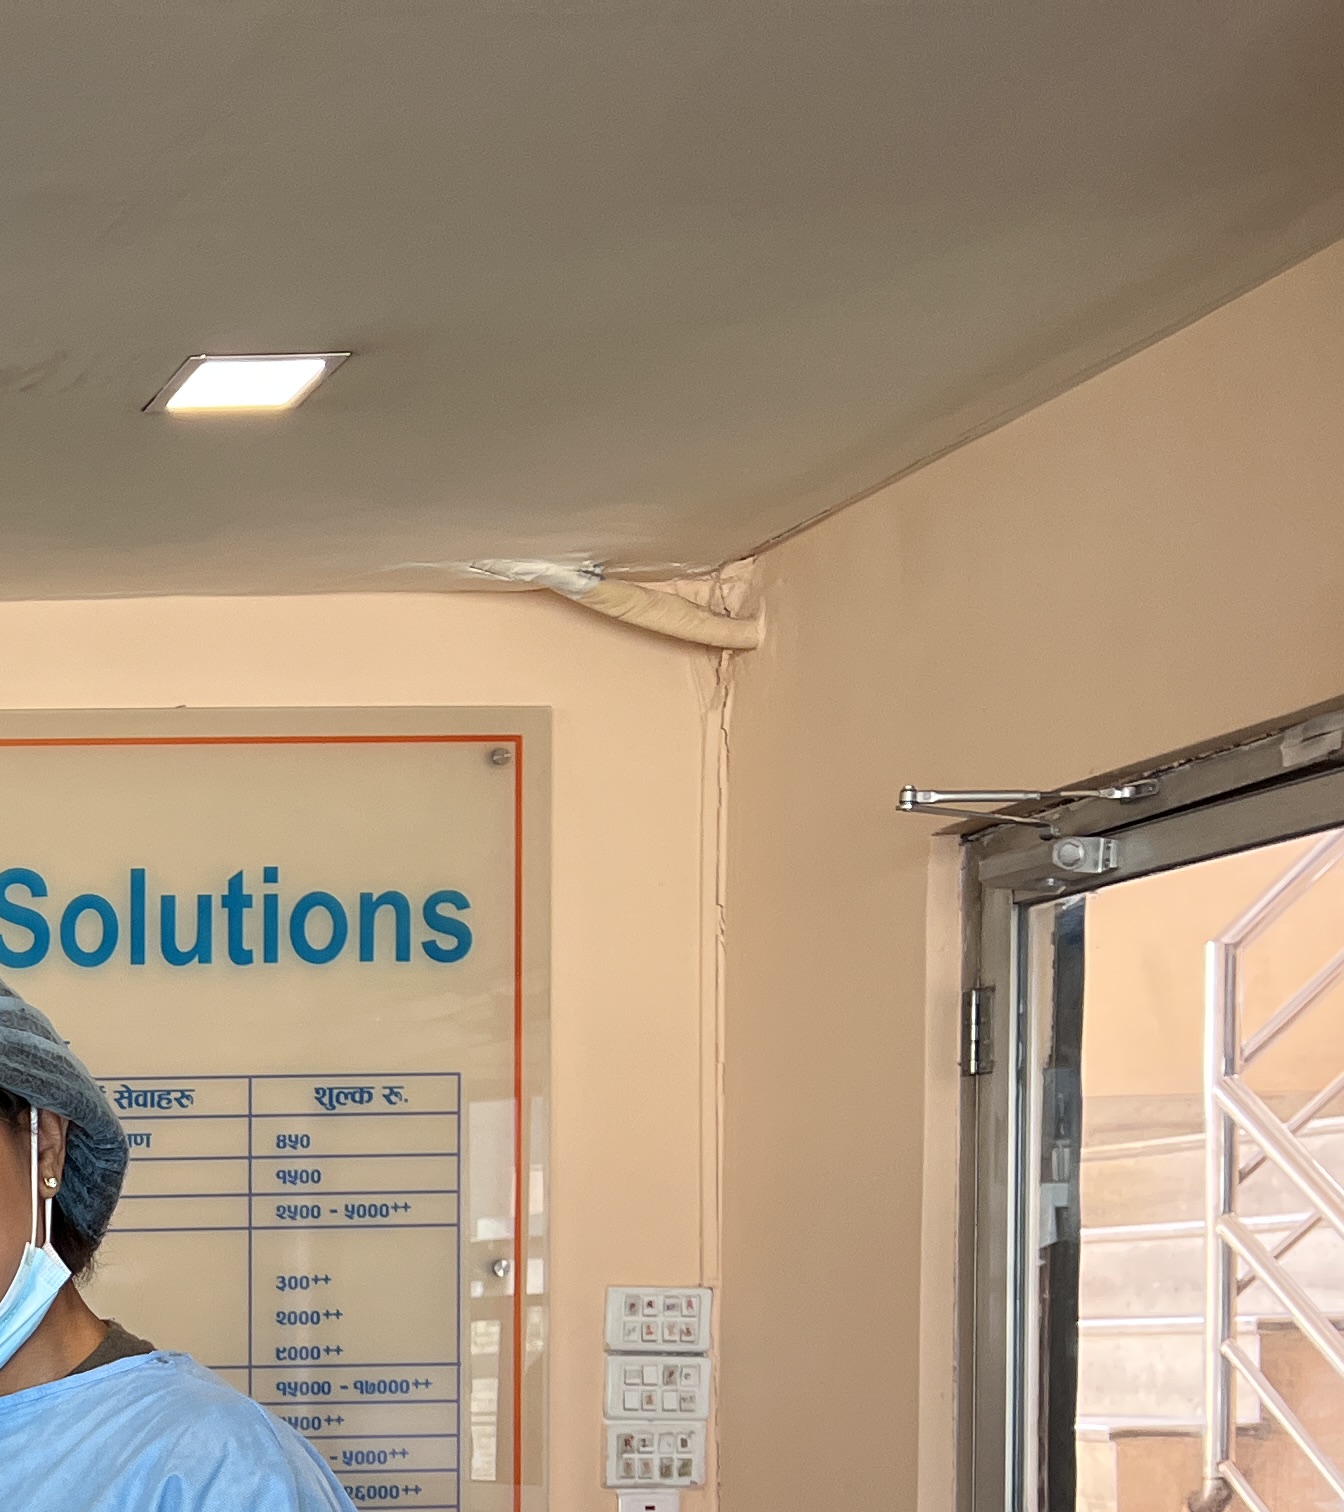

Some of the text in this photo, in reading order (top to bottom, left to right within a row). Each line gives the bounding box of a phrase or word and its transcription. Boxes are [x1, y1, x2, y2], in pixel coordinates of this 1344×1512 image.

[313, 1085, 376, 1111] शुल्क
[275, 1168, 322, 1186] १५००
[275, 1204, 322, 1221] २५००
